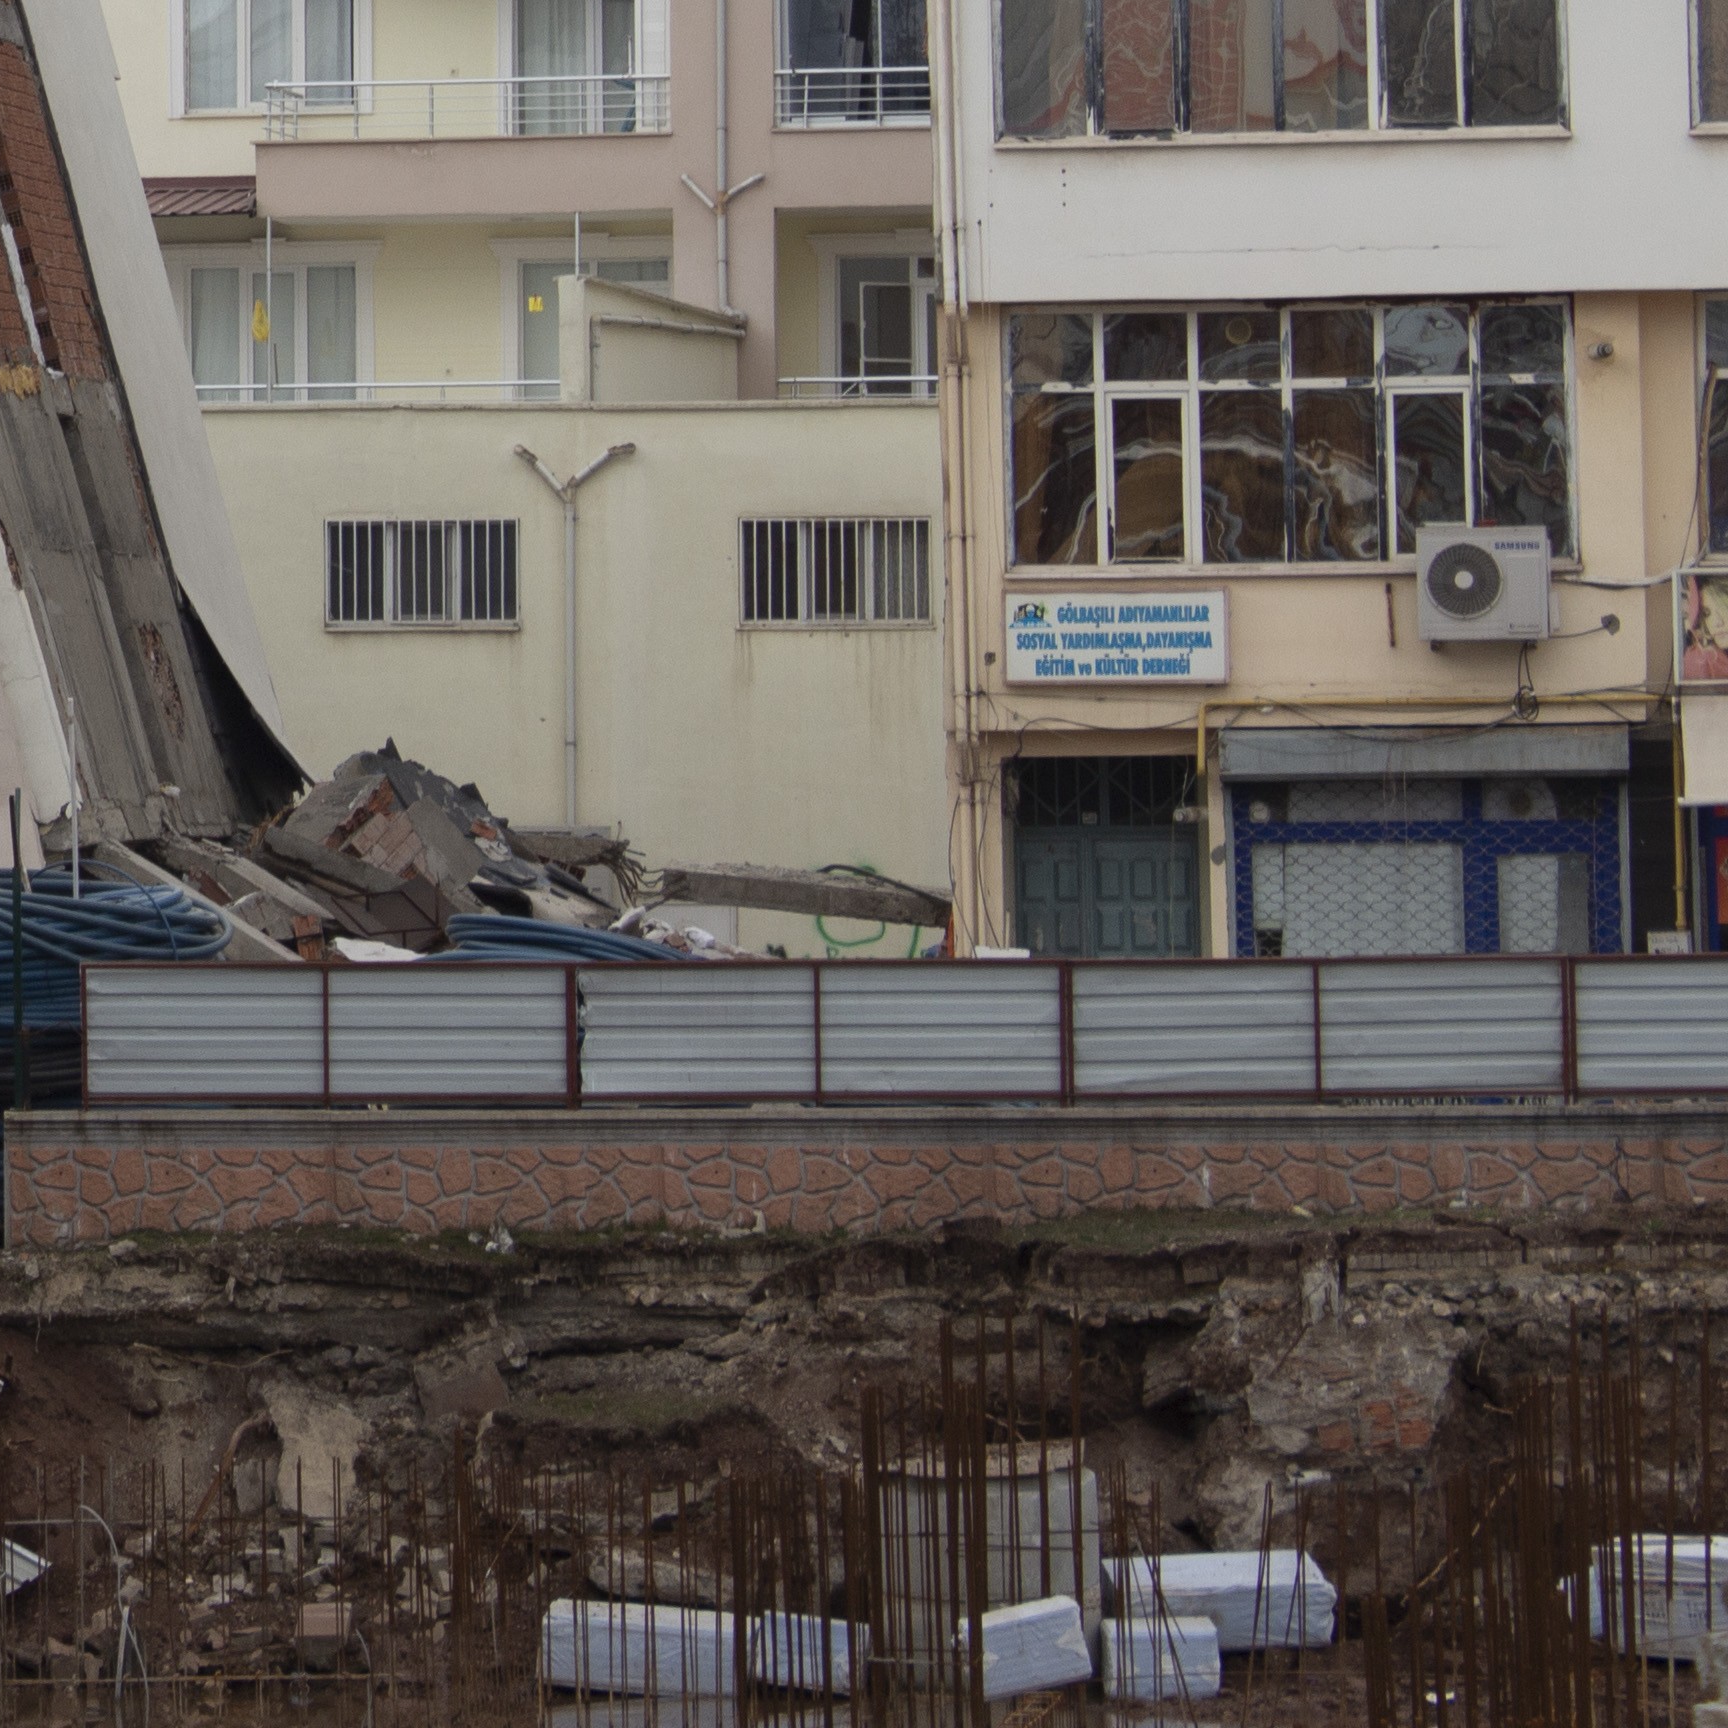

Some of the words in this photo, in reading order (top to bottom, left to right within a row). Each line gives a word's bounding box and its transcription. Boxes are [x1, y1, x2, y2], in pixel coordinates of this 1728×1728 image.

[1494, 541, 1540, 550] SAMSUNG
[1057, 602, 1115, 628] GÖLBAŞILI
[1118, 605, 1210, 622] ADIYAMANLILAR
[1016, 633, 1058, 650] SOSYAL
[1035, 654, 1075, 676] EĞİTİM
[1078, 663, 1092, 676] ve
[1095, 654, 1139, 676] KÜLTÜR
[1143, 653, 1191, 674] DERNEĞİ
